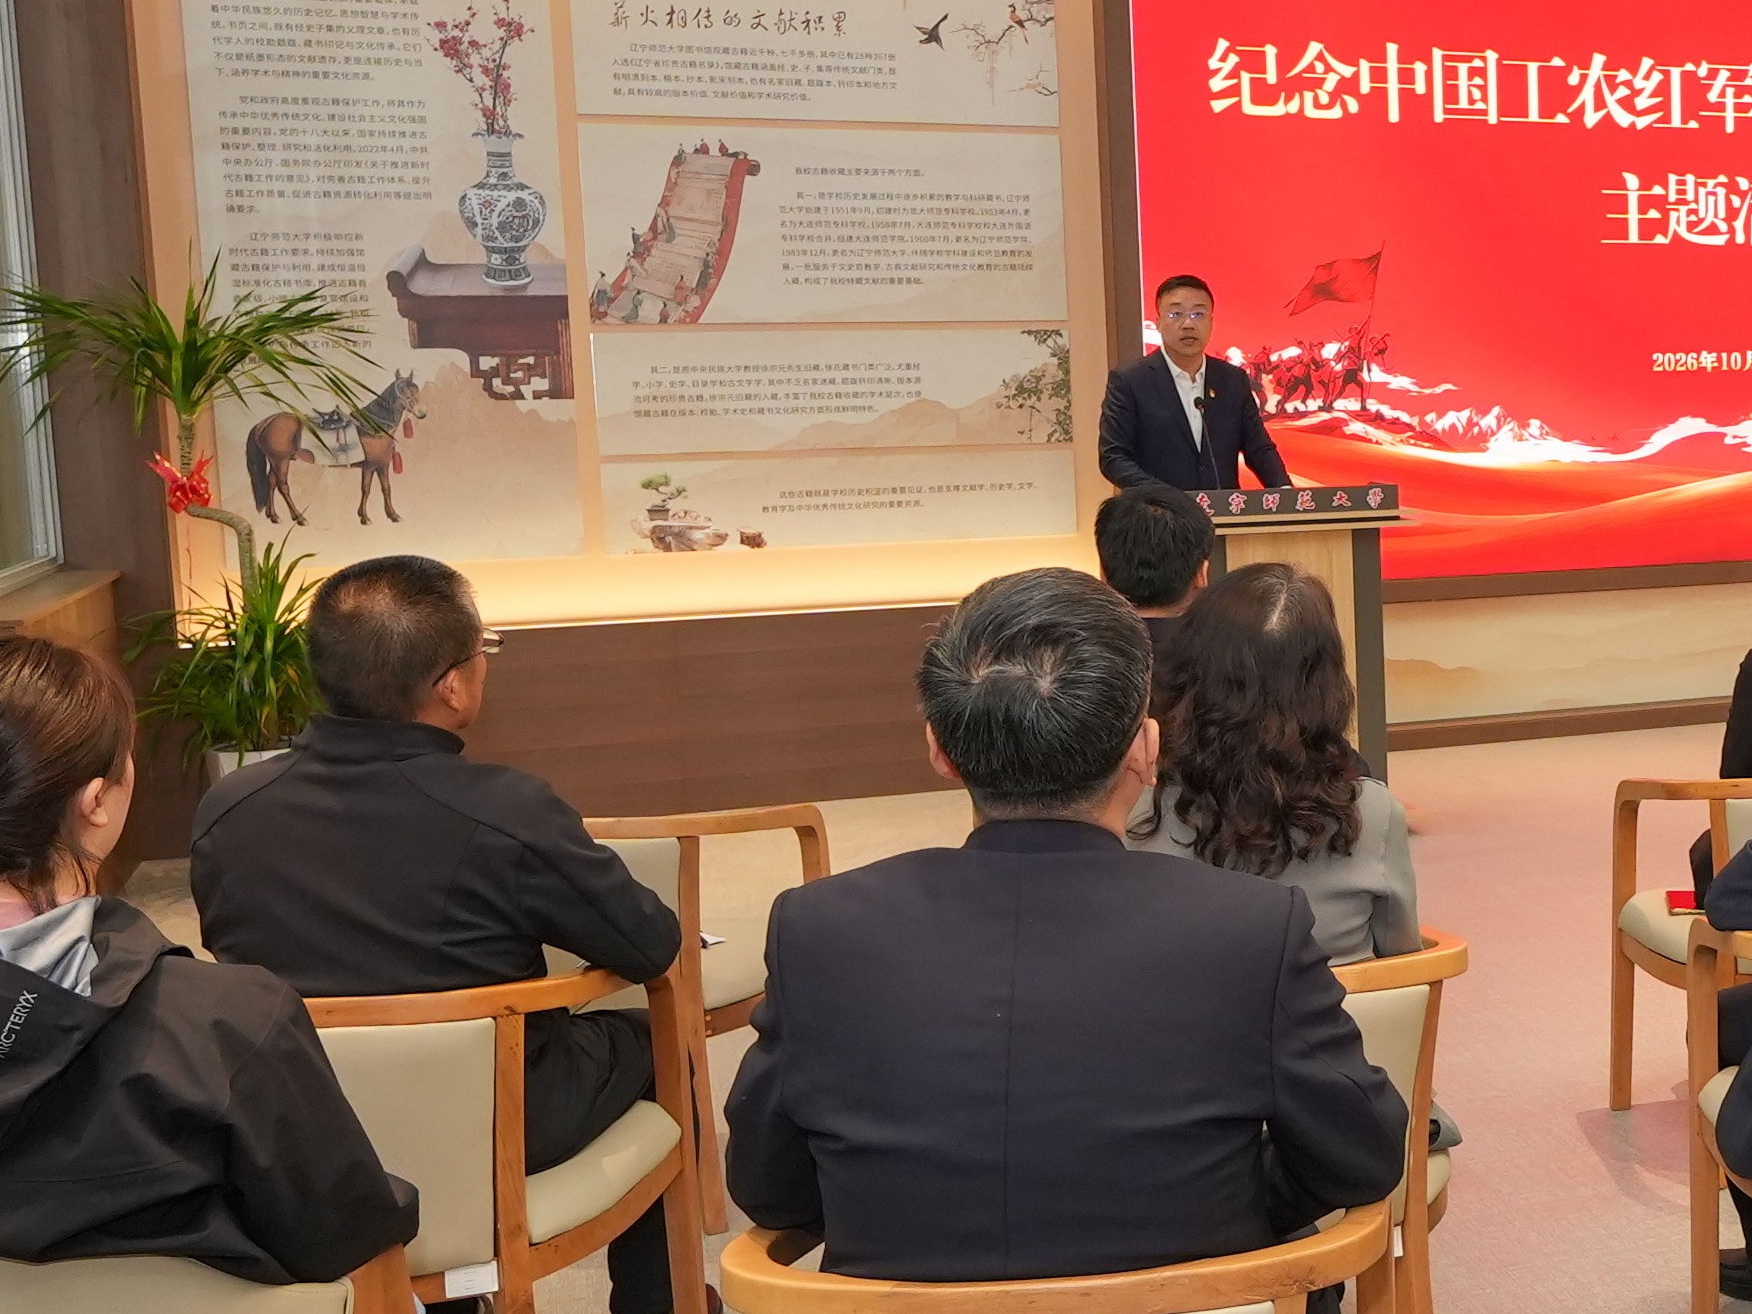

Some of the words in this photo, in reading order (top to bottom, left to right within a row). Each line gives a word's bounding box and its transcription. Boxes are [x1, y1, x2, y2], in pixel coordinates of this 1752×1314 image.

[608, 0, 848, 37] 薪火相传的文献积累
